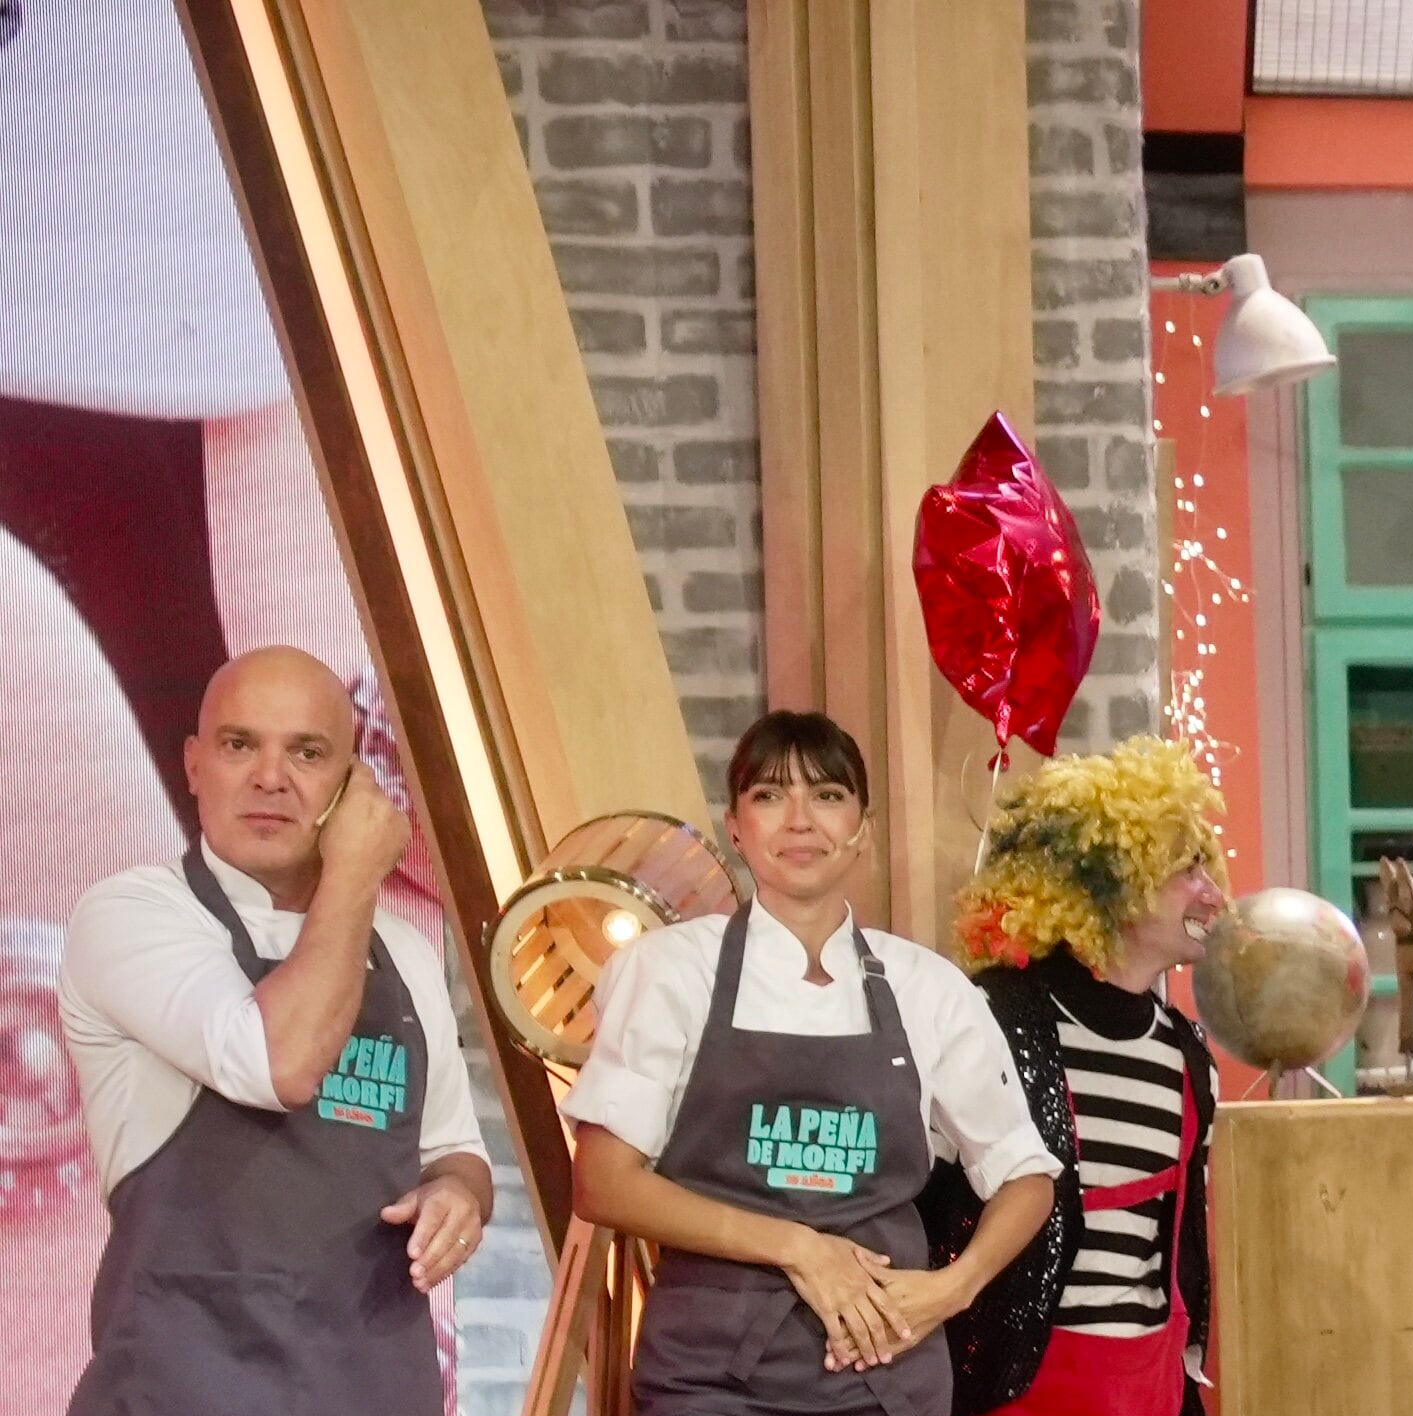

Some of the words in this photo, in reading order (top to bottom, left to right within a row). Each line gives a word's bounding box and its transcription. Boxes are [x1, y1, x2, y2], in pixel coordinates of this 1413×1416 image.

[337, 1034, 406, 1085] PEÑA
[322, 1073, 405, 1113] MORFI
[749, 1103, 793, 1141] LA
[797, 1105, 877, 1149] PEÑA
[747, 1138, 775, 1166] DE
[776, 1142, 877, 1174] MORFI
